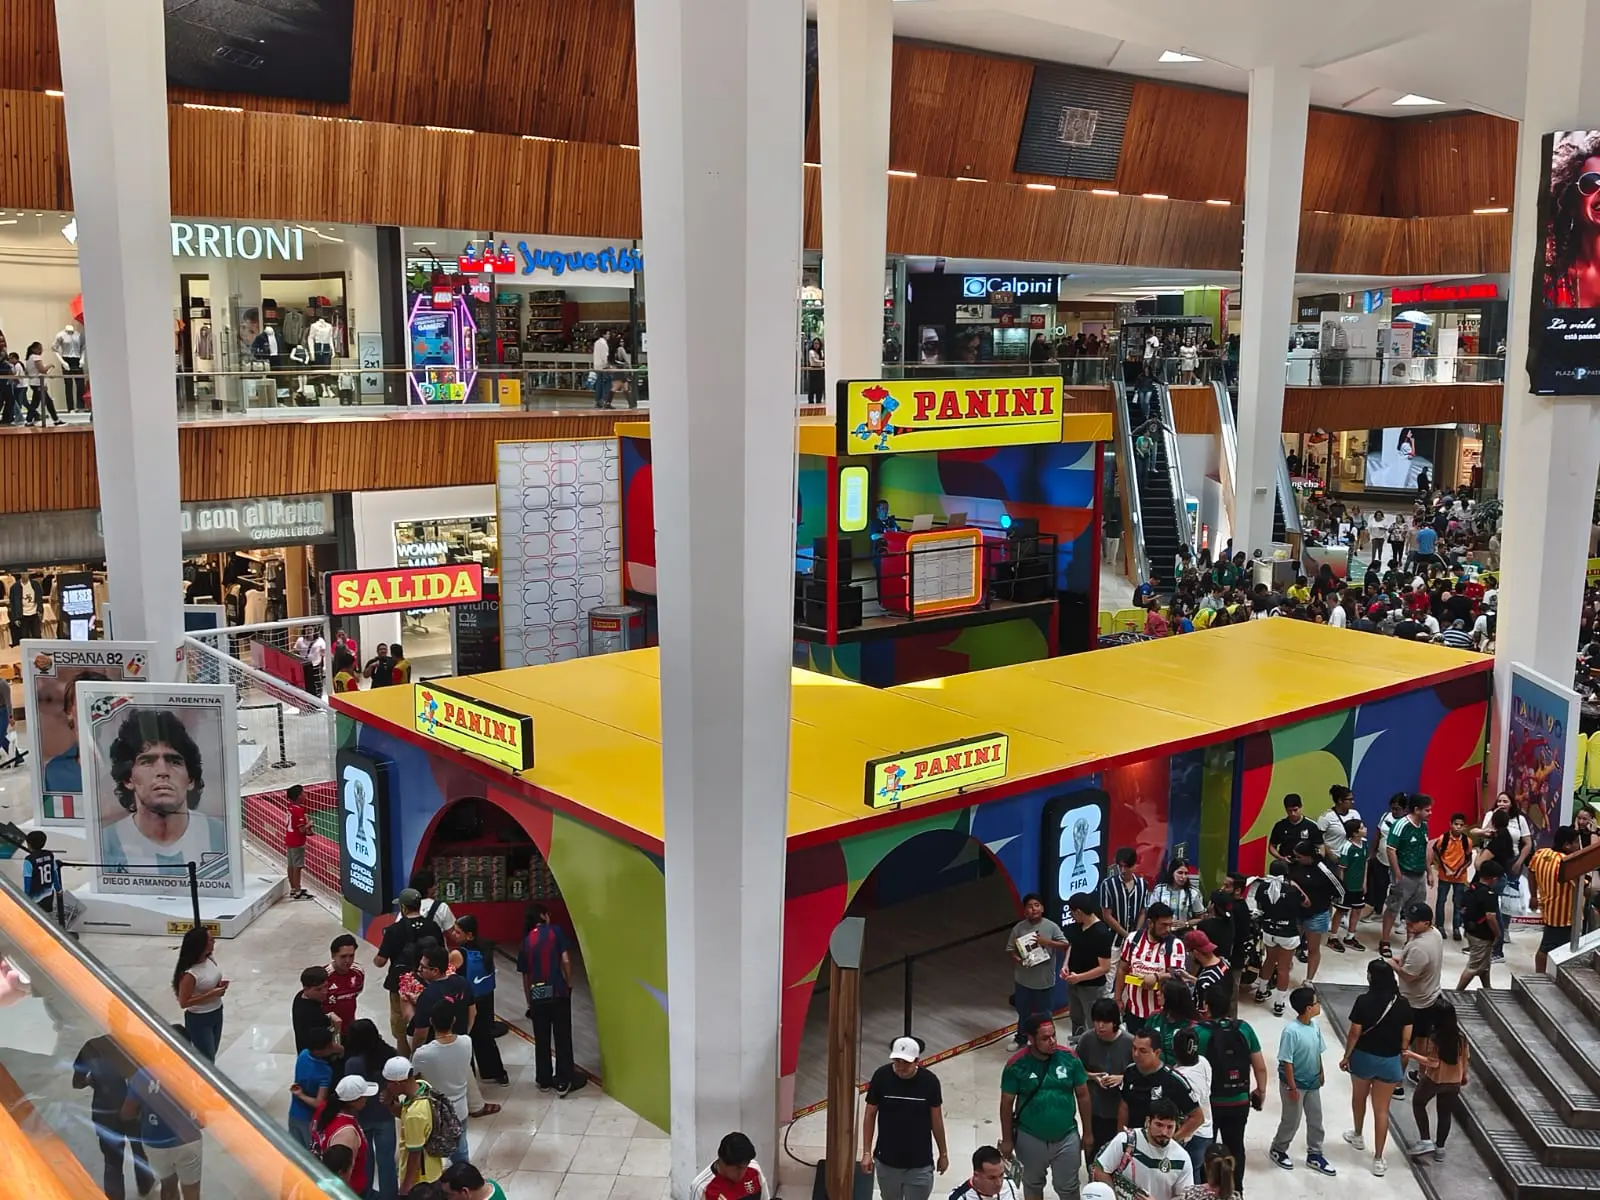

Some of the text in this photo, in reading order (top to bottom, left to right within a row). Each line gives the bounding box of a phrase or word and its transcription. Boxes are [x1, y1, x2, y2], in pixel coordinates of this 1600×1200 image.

[170, 222, 303, 260] RRIONI
[517, 240, 643, 276] juguetibi
[987, 277, 1052, 296] Calpini
[1546, 317, 1596, 329] La vida
[1578, 333, 1600, 341] pasand
[913, 387, 1055, 421] PANINI
[197, 508, 240, 532] con
[397, 541, 449, 557] WOMAN
[337, 571, 477, 609] SALIDA
[53, 651, 124, 665] ESPAÑA 82
[168, 696, 221, 704] ARGENTINA
[444, 702, 517, 747] PANINI
[914, 743, 1002, 780] PANINI
[355, 841, 369, 857] FIFA
[39, 865, 55, 889] 18
[102, 877, 232, 890] DIEGO ARMANDO MAADONA
[1070, 877, 1088, 892] FIFA
